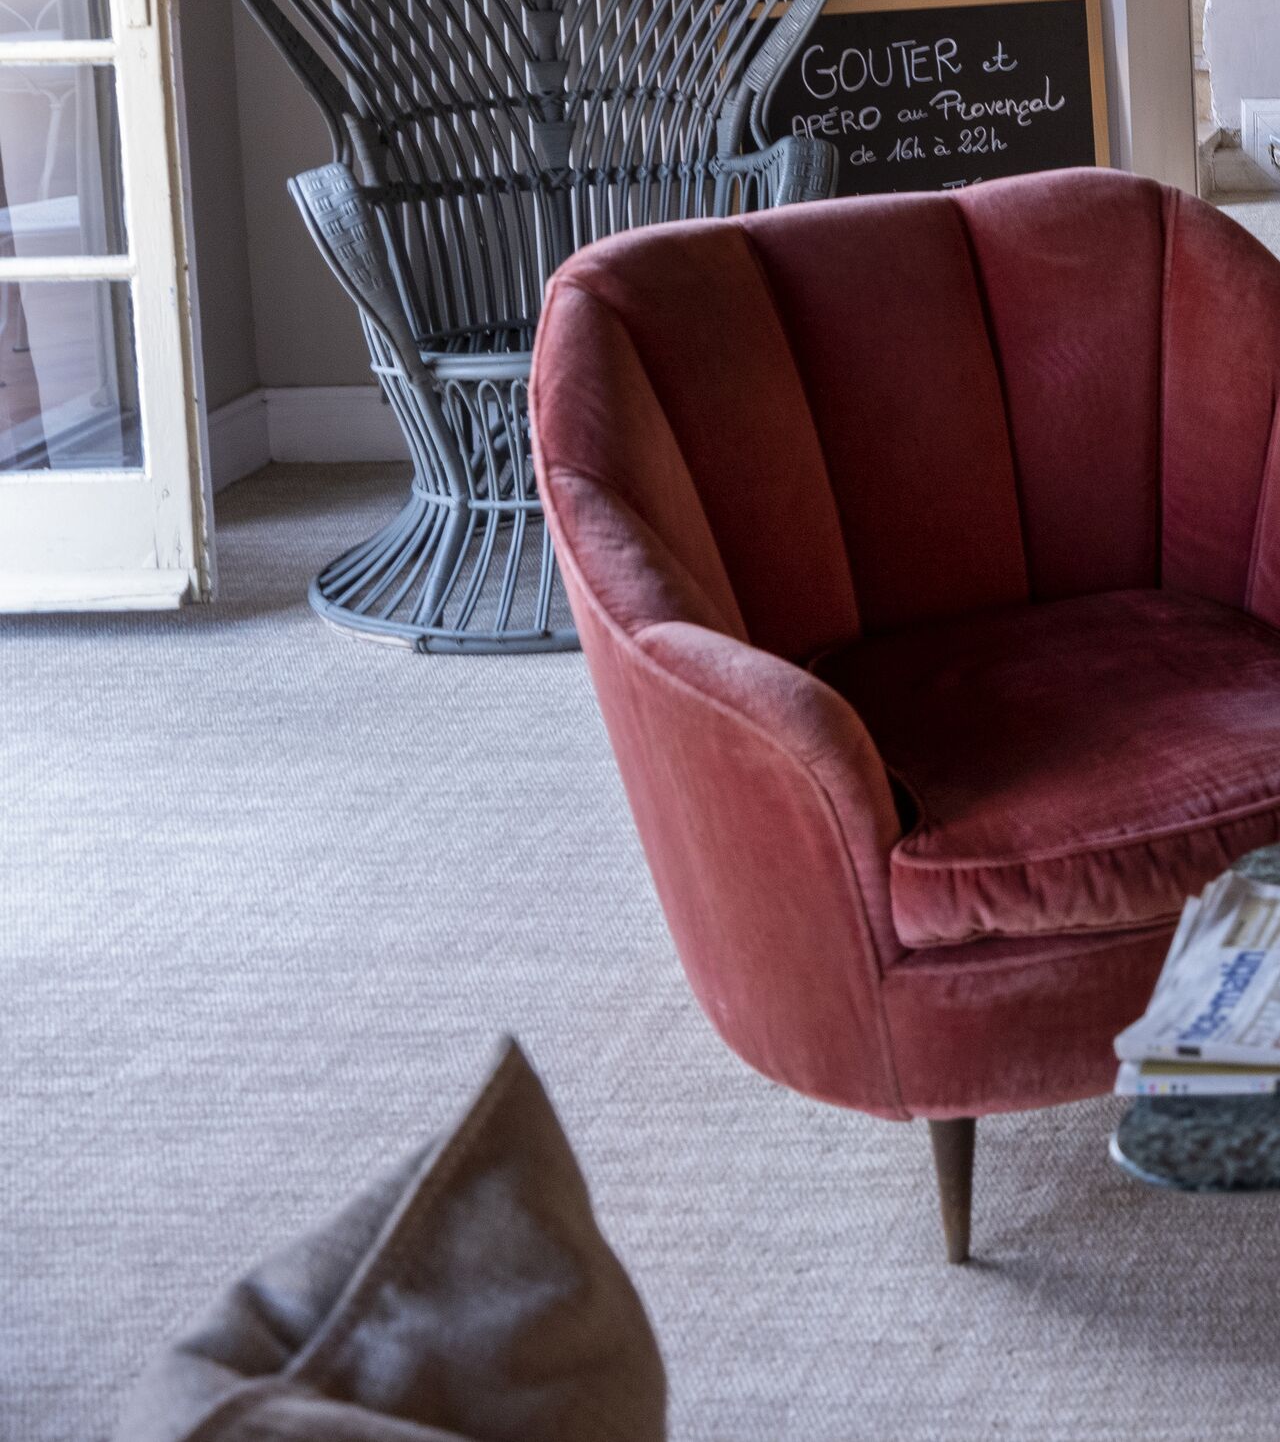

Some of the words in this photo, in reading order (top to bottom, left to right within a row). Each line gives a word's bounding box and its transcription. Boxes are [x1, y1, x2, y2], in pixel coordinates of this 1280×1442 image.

[802, 37, 962, 100] GOUTER
[982, 40, 1018, 72] et
[897, 108, 928, 123] au
[929, 74, 1065, 126] Provençal
[849, 143, 877, 166] de
[886, 136, 926, 162] 16h
[933, 136, 951, 155] à
[957, 125, 1008, 154] 22h
